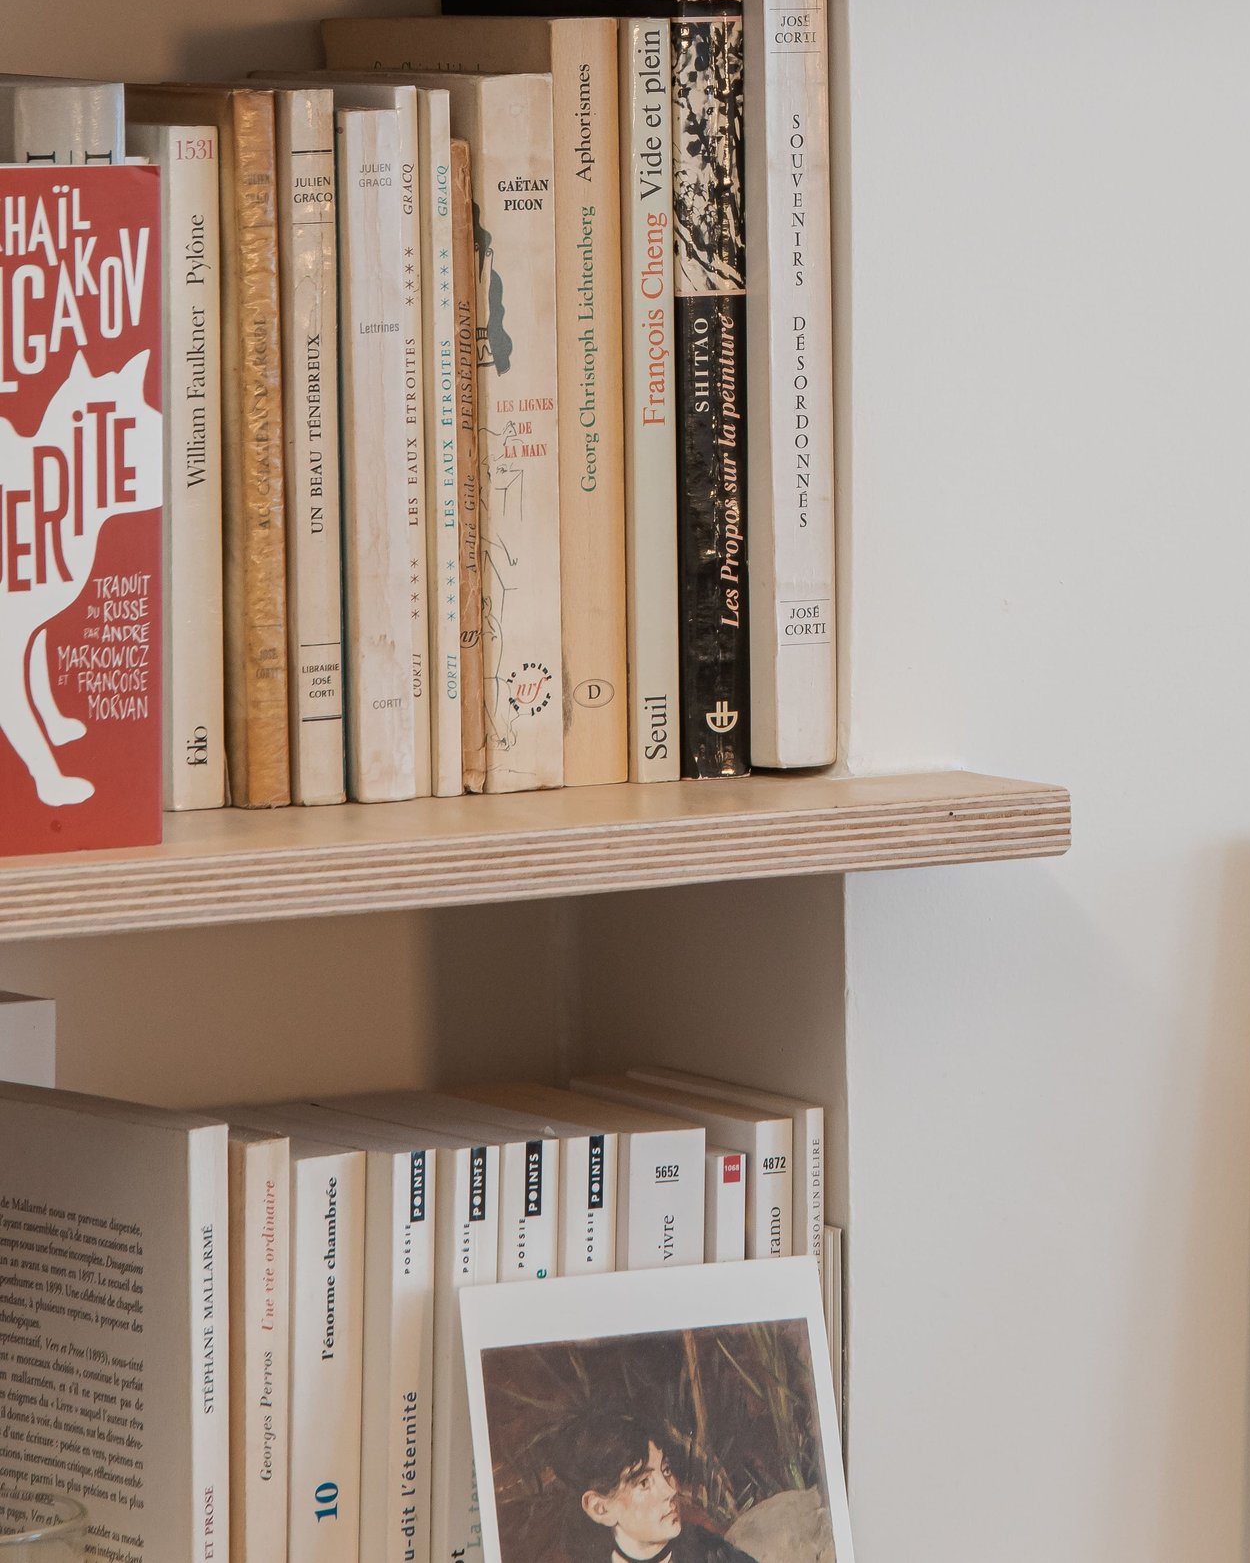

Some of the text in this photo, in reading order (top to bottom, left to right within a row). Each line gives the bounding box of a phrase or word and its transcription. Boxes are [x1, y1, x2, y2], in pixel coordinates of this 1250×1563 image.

[774, 30, 817, 44] CORTI
[175, 140, 214, 160] 1531
[359, 163, 392, 174] JULIEN
[293, 191, 334, 205] GRACQ
[294, 175, 331, 188] JULIEN
[358, 177, 393, 189] GRACQ
[402, 163, 415, 215] GRACQ
[436, 164, 449, 217] GRACQ
[497, 176, 550, 193] GAËTAN
[789, 114, 806, 287] SOUVENIRS
[503, 197, 544, 211] PICON
[637, 29, 670, 426] François Cheng Vide et plein
[574, 62, 600, 492] Georg Christoph Lichtenberg Aphorismes
[359, 321, 401, 335] Lettrines
[185, 214, 211, 489] William Faulkner Pylône
[694, 317, 710, 413] SHITAO
[496, 398, 555, 413] LES LIGNES
[306, 333, 324, 535] UN BEAU TÉNÉBREUX
[457, 300, 478, 574] André Gide PERSÉPHONE
[519, 421, 532, 435] DE
[407, 434, 418, 485] EAUX
[443, 436, 455, 487] EAUX
[504, 443, 548, 458] LA MAIN
[720, 315, 744, 629] Les Propos sur la peinture
[408, 496, 419, 526] LES
[444, 498, 455, 527] LES
[92, 571, 151, 599] TRADUIT
[103, 598, 149, 622] RUSSE
[784, 622, 827, 636] CORTI
[790, 605, 820, 620] JOSÉ
[57, 645, 150, 673] MARKOWICZ
[302, 663, 340, 675] LIBRAIRIE
[311, 674, 333, 686] JOSÉ
[411, 652, 422, 699] CORTI
[446, 653, 458, 700] CORTI
[77, 667, 148, 696] FRANÇOISE
[309, 688, 335, 699] CORTI
[588, 684, 600, 699] D
[88, 693, 148, 721] MORVAN
[372, 698, 402, 710] CORTI
[187, 725, 208, 767] folio
[644, 693, 668, 759] Seuil
[528, 1153, 540, 1212] POINTS
[591, 1146, 602, 1203] POINTS
[655, 1165, 680, 1179] 5652
[763, 1156, 786, 1170] 4872
[811, 1138, 821, 1187] DÉLIRE
[12, 1198, 47, 1215] Mallarmé
[413, 1157, 423, 1218] POINTS
[472, 1157, 484, 1217] POINTS
[812, 1191, 822, 1208] UN
[402, 1224, 412, 1274] POÉSIE
[462, 1222, 471, 1273] POÉSIE
[516, 1218, 527, 1269] POÉSIE
[585, 1212, 595, 1262] POÉSIE
[657, 1214, 675, 1261] vivre
[321, 1176, 338, 1361] l'énorme chambrée
[202, 1223, 215, 1414] STÉPHANE MALLARMÉ
[259, 1180, 276, 1482] Georges Perros Une vie ordinaire
[401, 1391, 418, 1497] l'éternité
[204, 1485, 215, 1560] ET PROSE
[314, 1481, 340, 1524] 10
